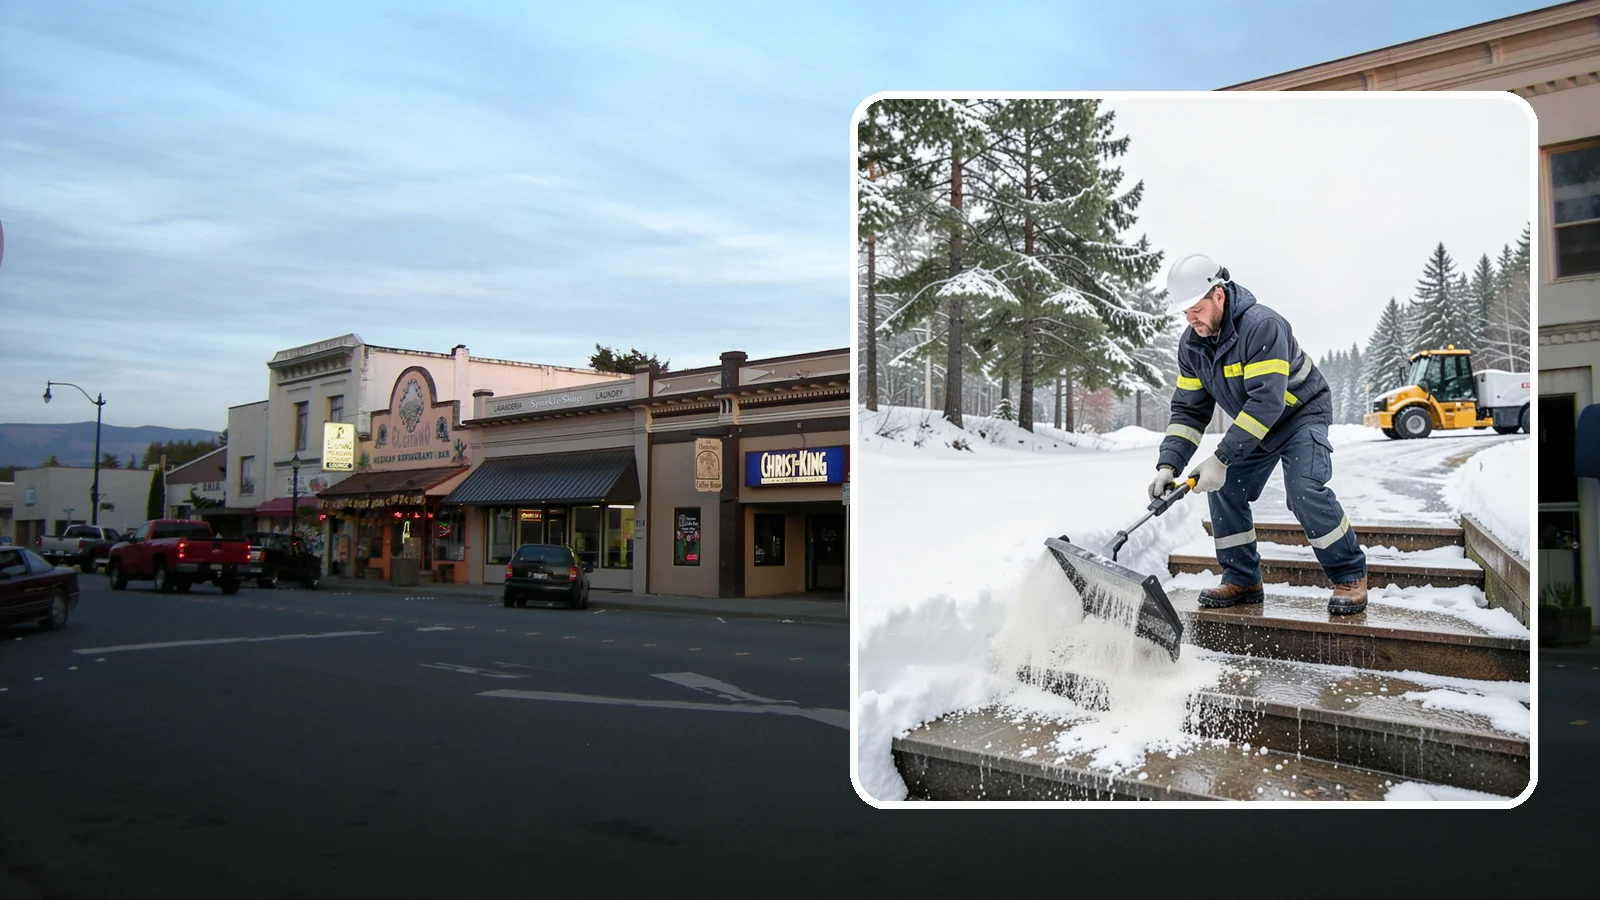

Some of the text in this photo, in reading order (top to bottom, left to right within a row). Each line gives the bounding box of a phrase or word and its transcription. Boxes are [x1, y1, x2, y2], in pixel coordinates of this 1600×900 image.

[595, 389, 623, 400] LAUNDRY
[493, 402, 523, 412] LAVANDERIA
[531, 395, 582, 408] Sparkle Shop
[374, 455, 396, 464] MEXICAN
[397, 451, 434, 462] RESTAURANT
[438, 450, 450, 459] BAR
[760, 450, 827, 478] CHRIST KING
[697, 481, 722, 489] Coffee House
